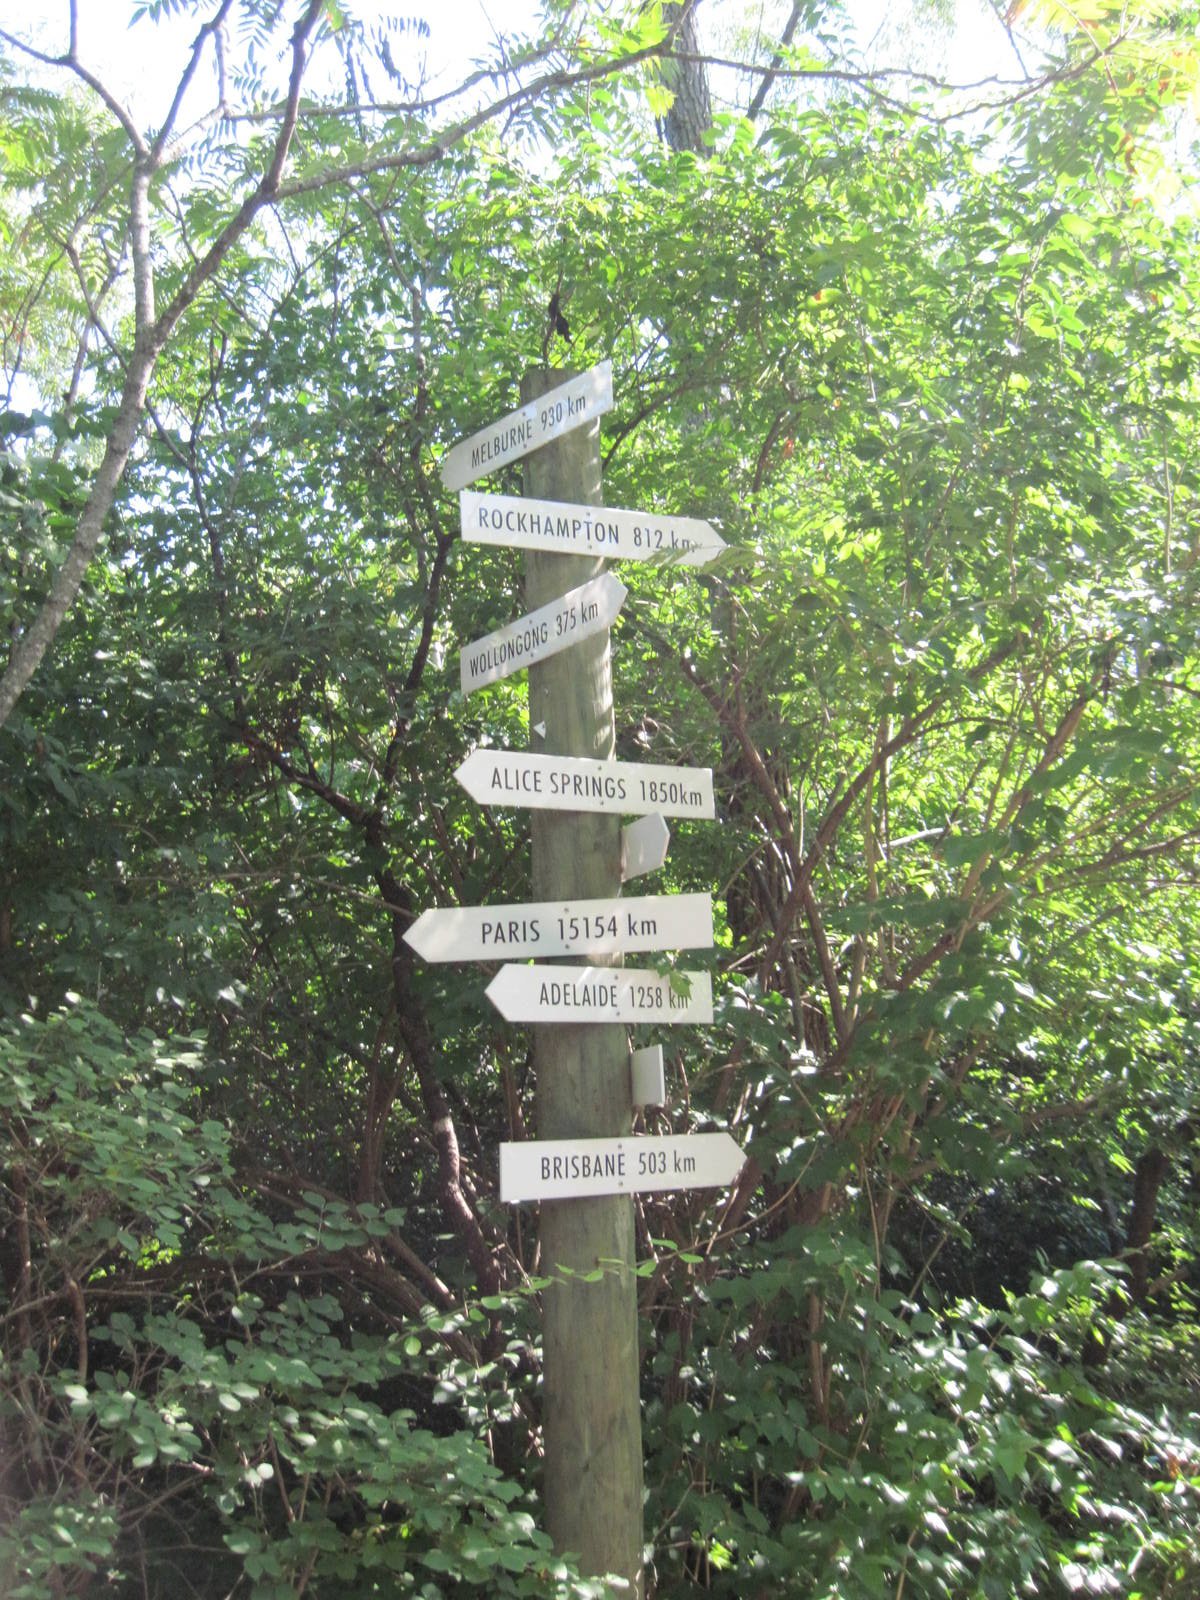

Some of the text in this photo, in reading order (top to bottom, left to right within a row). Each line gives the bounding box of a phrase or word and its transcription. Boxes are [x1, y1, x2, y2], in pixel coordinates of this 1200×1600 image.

[471, 392, 586, 469] MELBURNE 930 km
[478, 507, 620, 545] ROCKHAMPTON
[633, 527, 663, 549] 812
[469, 600, 599, 678] WOLLONGONG 375 km
[491, 767, 542, 794] ALICE
[550, 772, 627, 800] SPRINGS
[481, 912, 658, 945] PARIS 15154 km
[539, 982, 689, 1010] ADELAIDE 1258 km
[540, 1150, 697, 1180] BRISBANE 503 km
